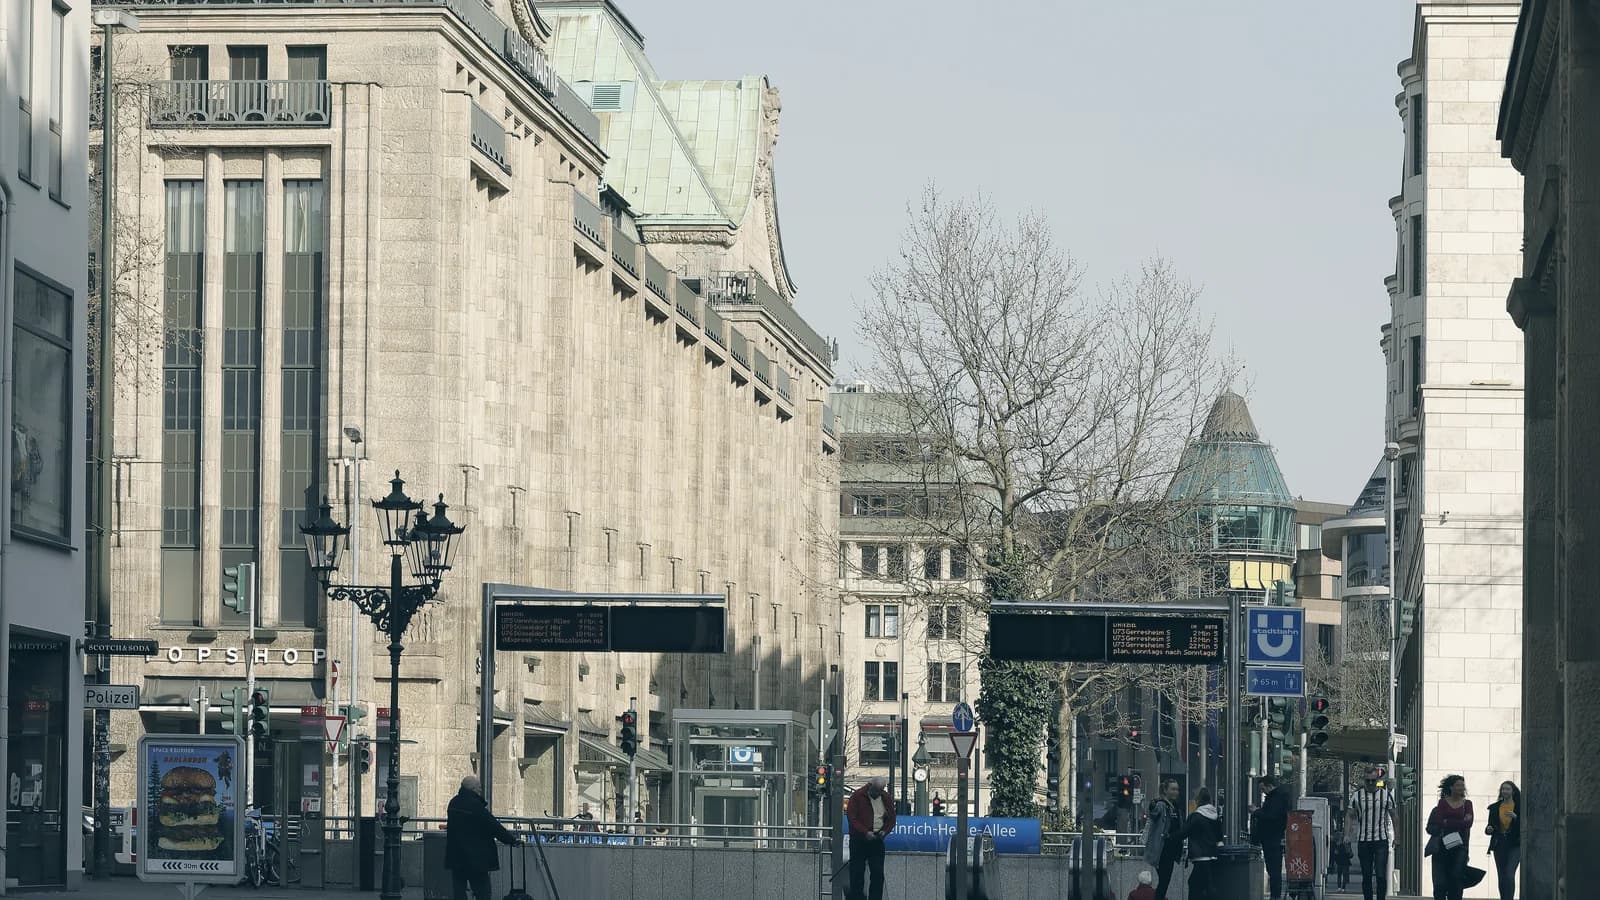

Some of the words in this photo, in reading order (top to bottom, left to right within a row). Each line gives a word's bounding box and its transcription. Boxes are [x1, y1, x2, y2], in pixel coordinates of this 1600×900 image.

[145, 647, 328, 664] OPSHOP
[1260, 678, 1270, 686] 65
[87, 690, 135, 704] Polizei
